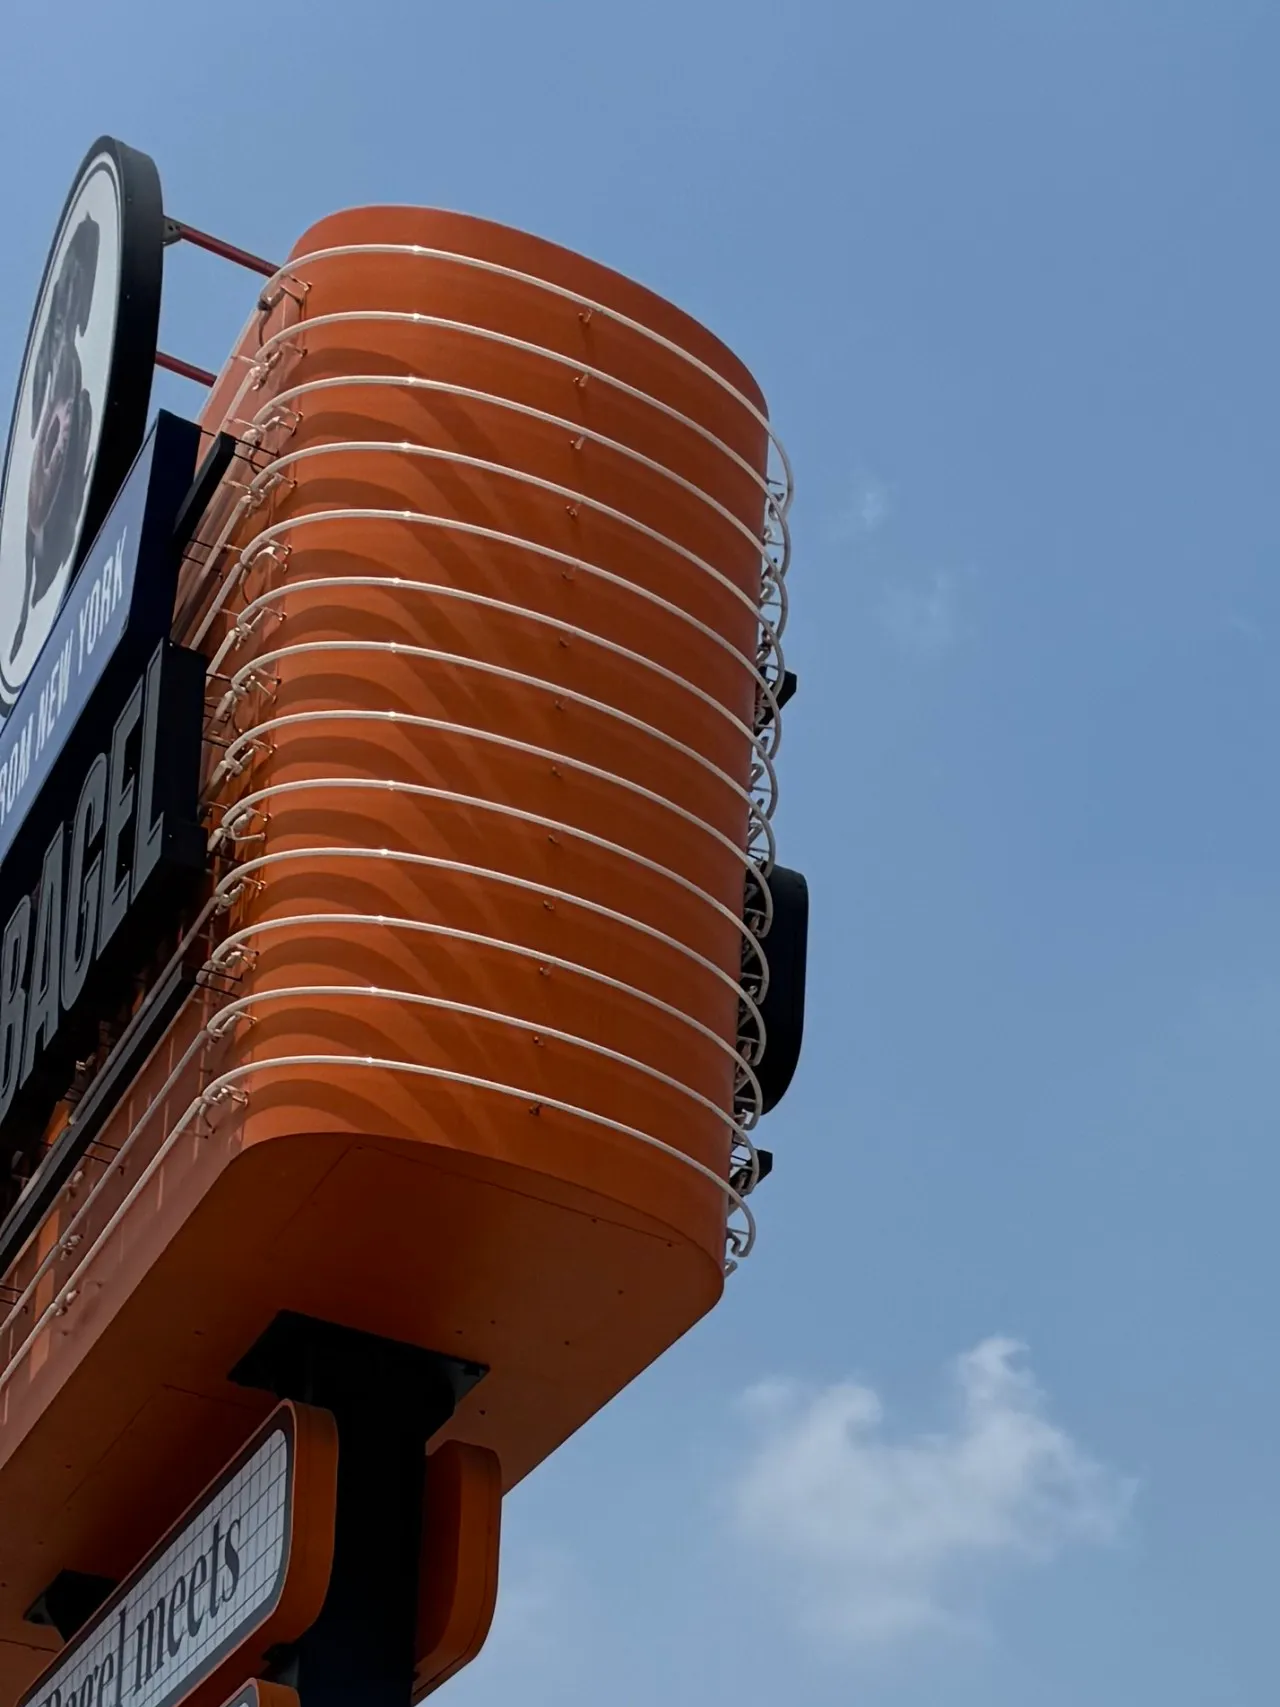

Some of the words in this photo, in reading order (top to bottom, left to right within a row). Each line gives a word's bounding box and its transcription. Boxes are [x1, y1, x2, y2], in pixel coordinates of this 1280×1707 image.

[35, 629, 75, 762] NEW
[77, 525, 128, 676] YORK
[0, 637, 164, 1124] BAGEL
[133, 1515, 241, 1691] meets
